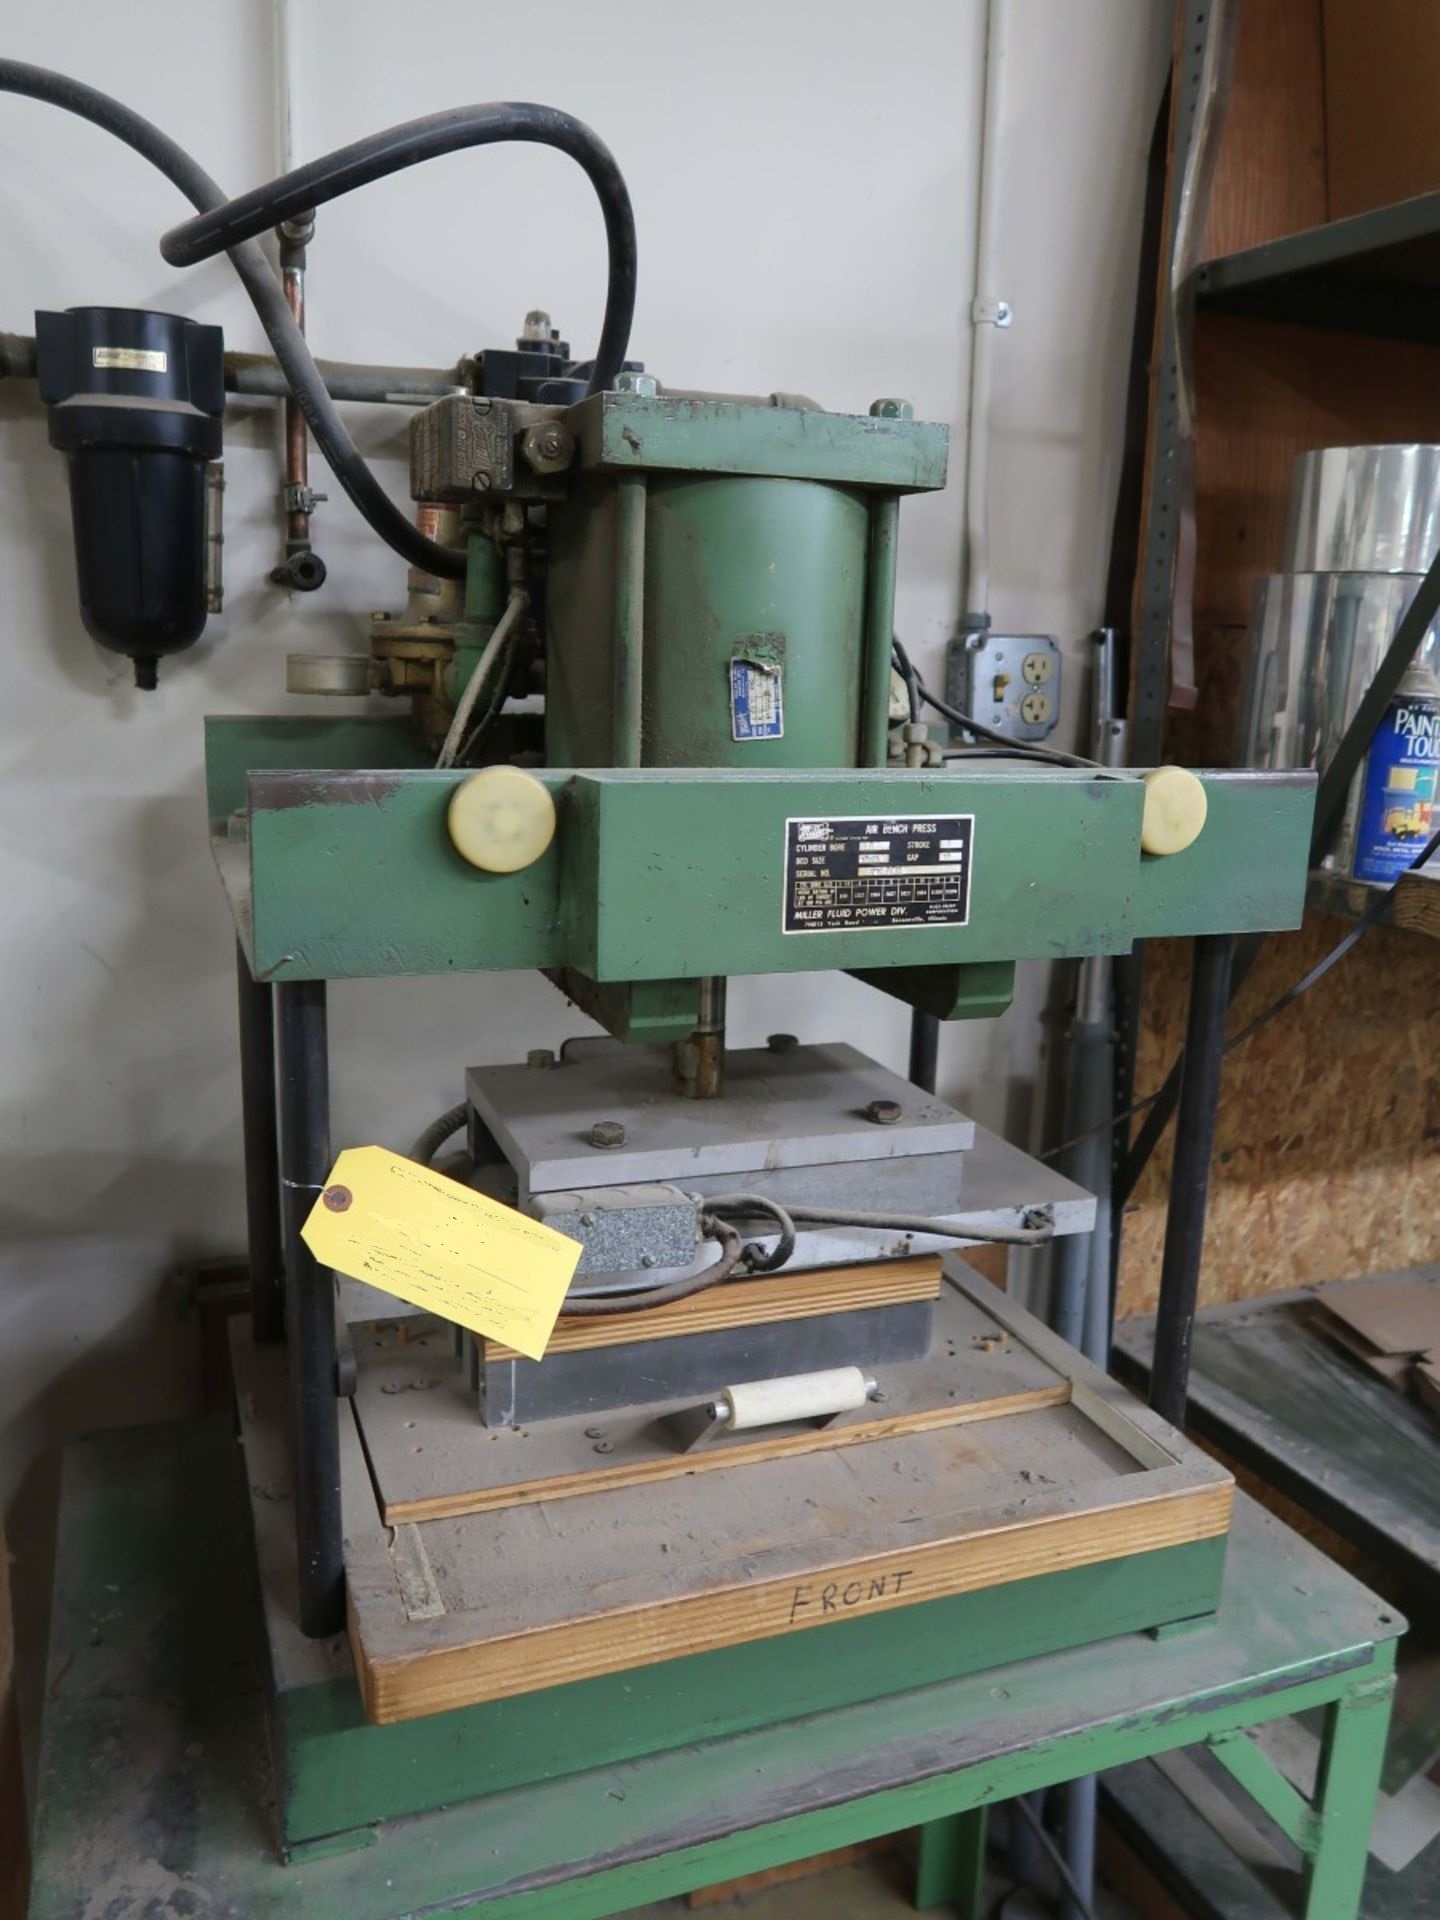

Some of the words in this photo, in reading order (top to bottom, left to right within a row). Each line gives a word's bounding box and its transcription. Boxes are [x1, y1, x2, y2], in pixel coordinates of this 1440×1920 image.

[865, 824, 879, 834] AIR
[912, 823, 937, 833] PRESS
[907, 841, 930, 849] STROKE
[812, 856, 826, 864] SIZE
[906, 853, 919, 862] GAP
[795, 869, 817, 878] SERIAL
[794, 909, 823, 920] MILLER
[827, 908, 852, 918] FLUID
[855, 907, 887, 917] POWER
[891, 906, 908, 916] DIV.
[789, 1570, 913, 1624] FRONT
